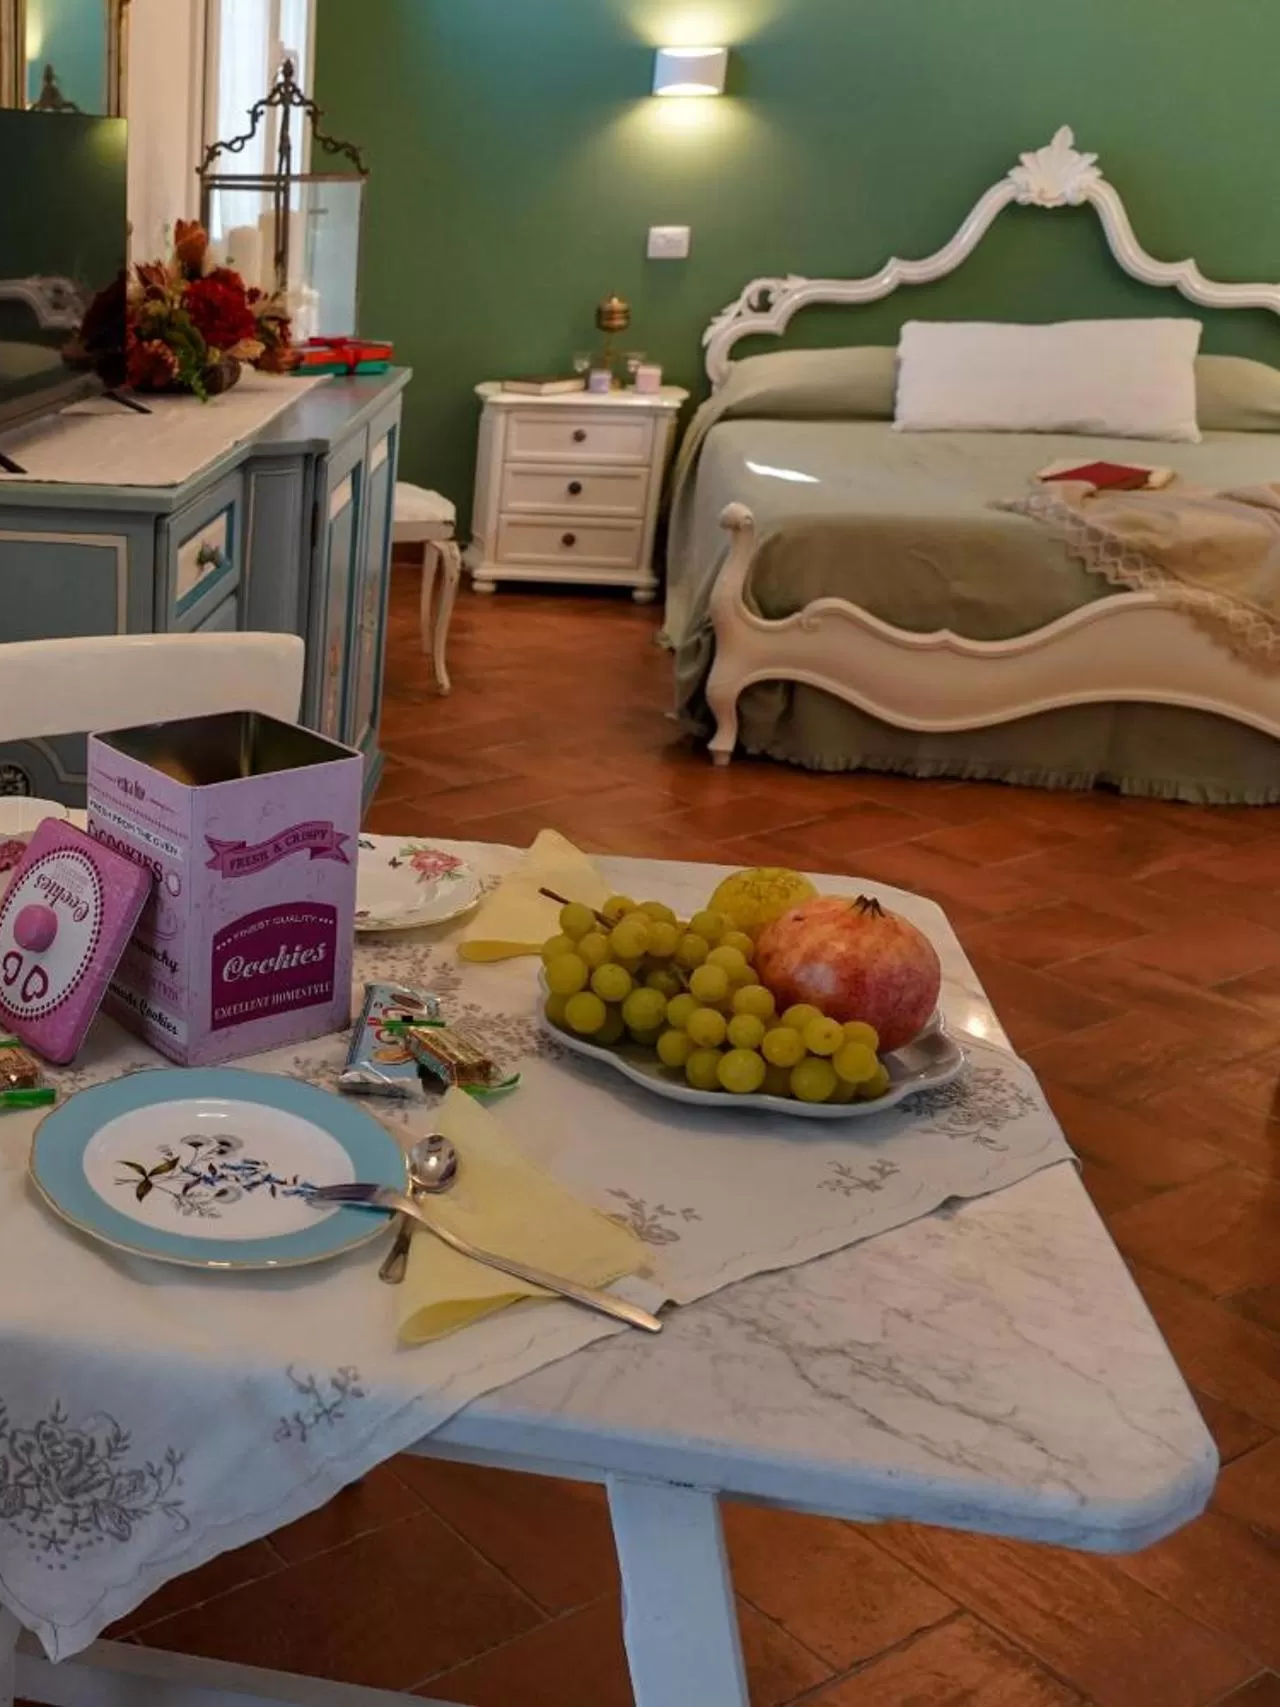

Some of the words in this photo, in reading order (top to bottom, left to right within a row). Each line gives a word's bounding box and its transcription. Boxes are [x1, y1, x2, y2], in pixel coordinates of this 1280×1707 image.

[228, 852, 270, 872] FRESH
[273, 842, 283, 854] &
[284, 828, 329, 847] CRISPY
[33, 873, 90, 922] Cookies
[233, 919, 270, 940] FINEST
[273, 913, 318, 927] QUALITY
[221, 941, 328, 983] Cookies
[139, 998, 179, 1036] Cookies
[213, 994, 271, 1021] EXCELLENT
[271, 981, 333, 1009] HOMESTYLE
